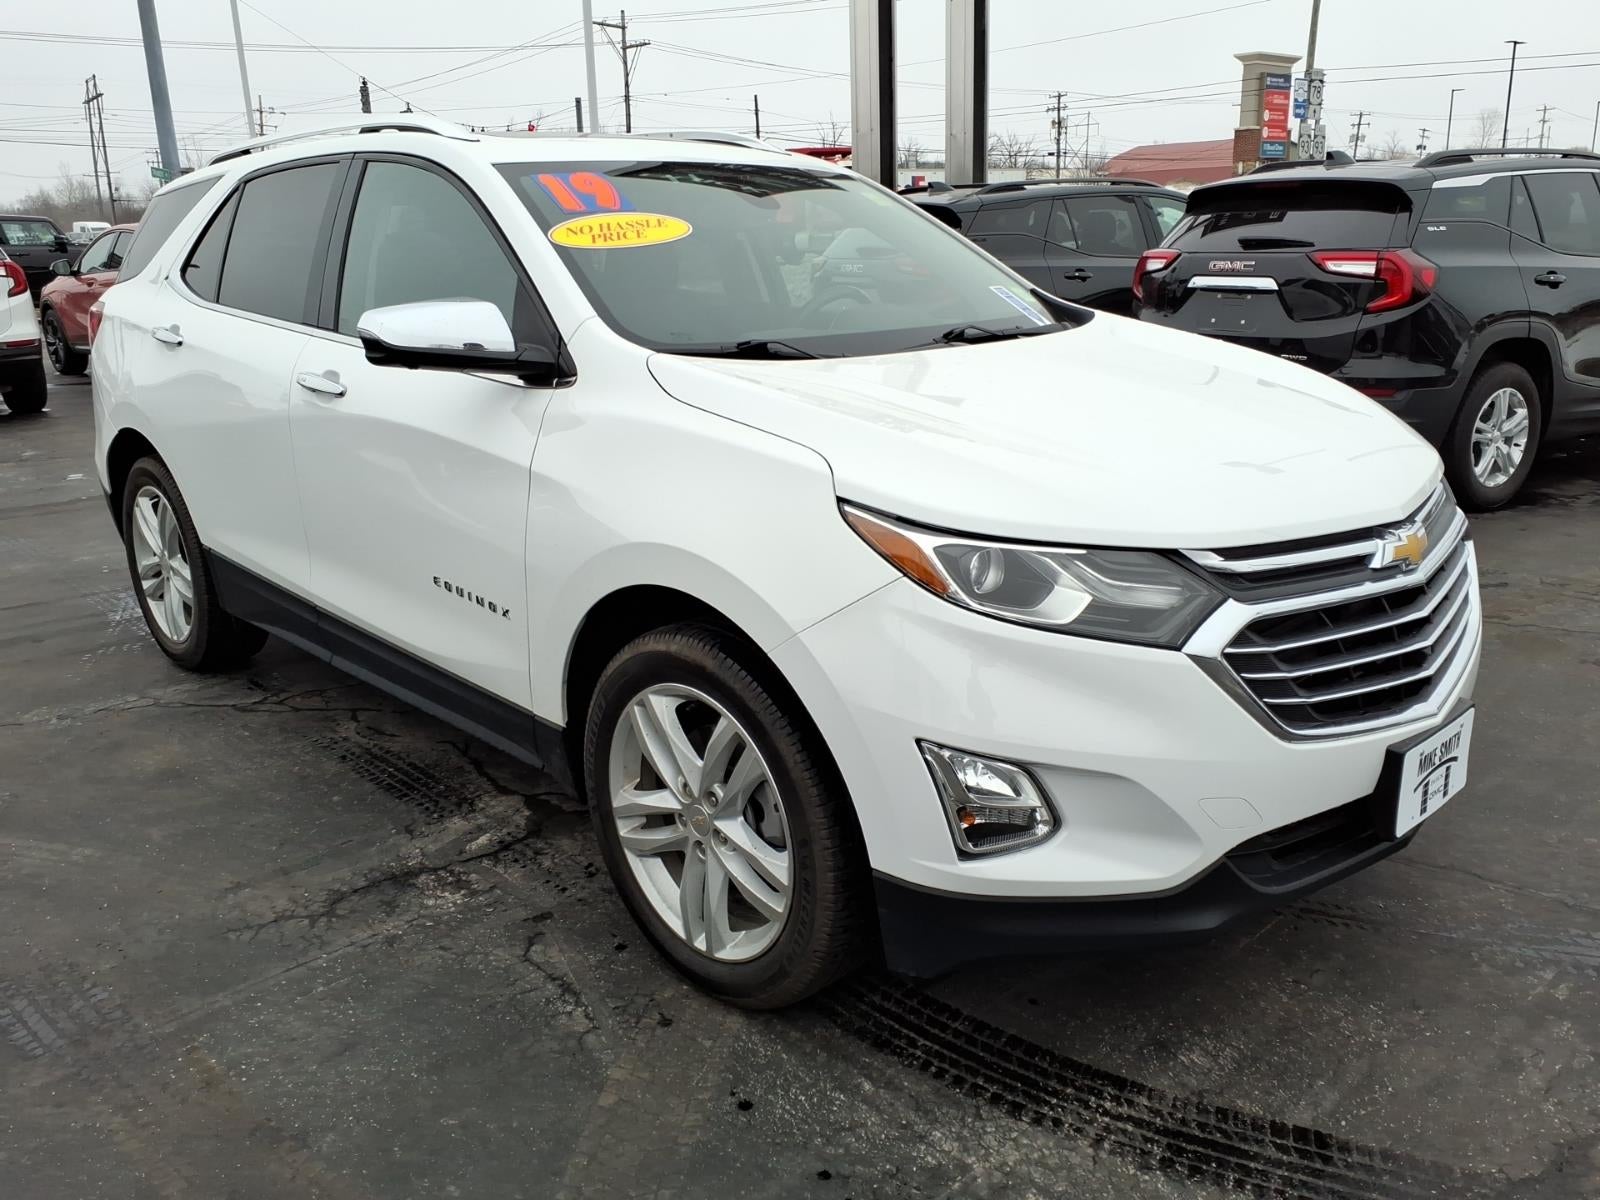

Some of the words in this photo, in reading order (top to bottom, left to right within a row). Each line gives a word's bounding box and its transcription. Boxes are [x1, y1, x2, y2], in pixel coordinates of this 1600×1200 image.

[1312, 85, 1322, 100] 78
[1300, 140, 1310, 154] 93
[1315, 140, 1324, 155] 93
[538, 171, 621, 212] 19
[565, 223, 594, 238] NO
[598, 217, 668, 233] HASSLE
[591, 229, 648, 245] PRICE
[1208, 260, 1256, 272] GMC
[432, 575, 511, 621] EQUINOX
[1417, 747, 1439, 778] MIKE
[1439, 729, 1462, 763] SMITH
